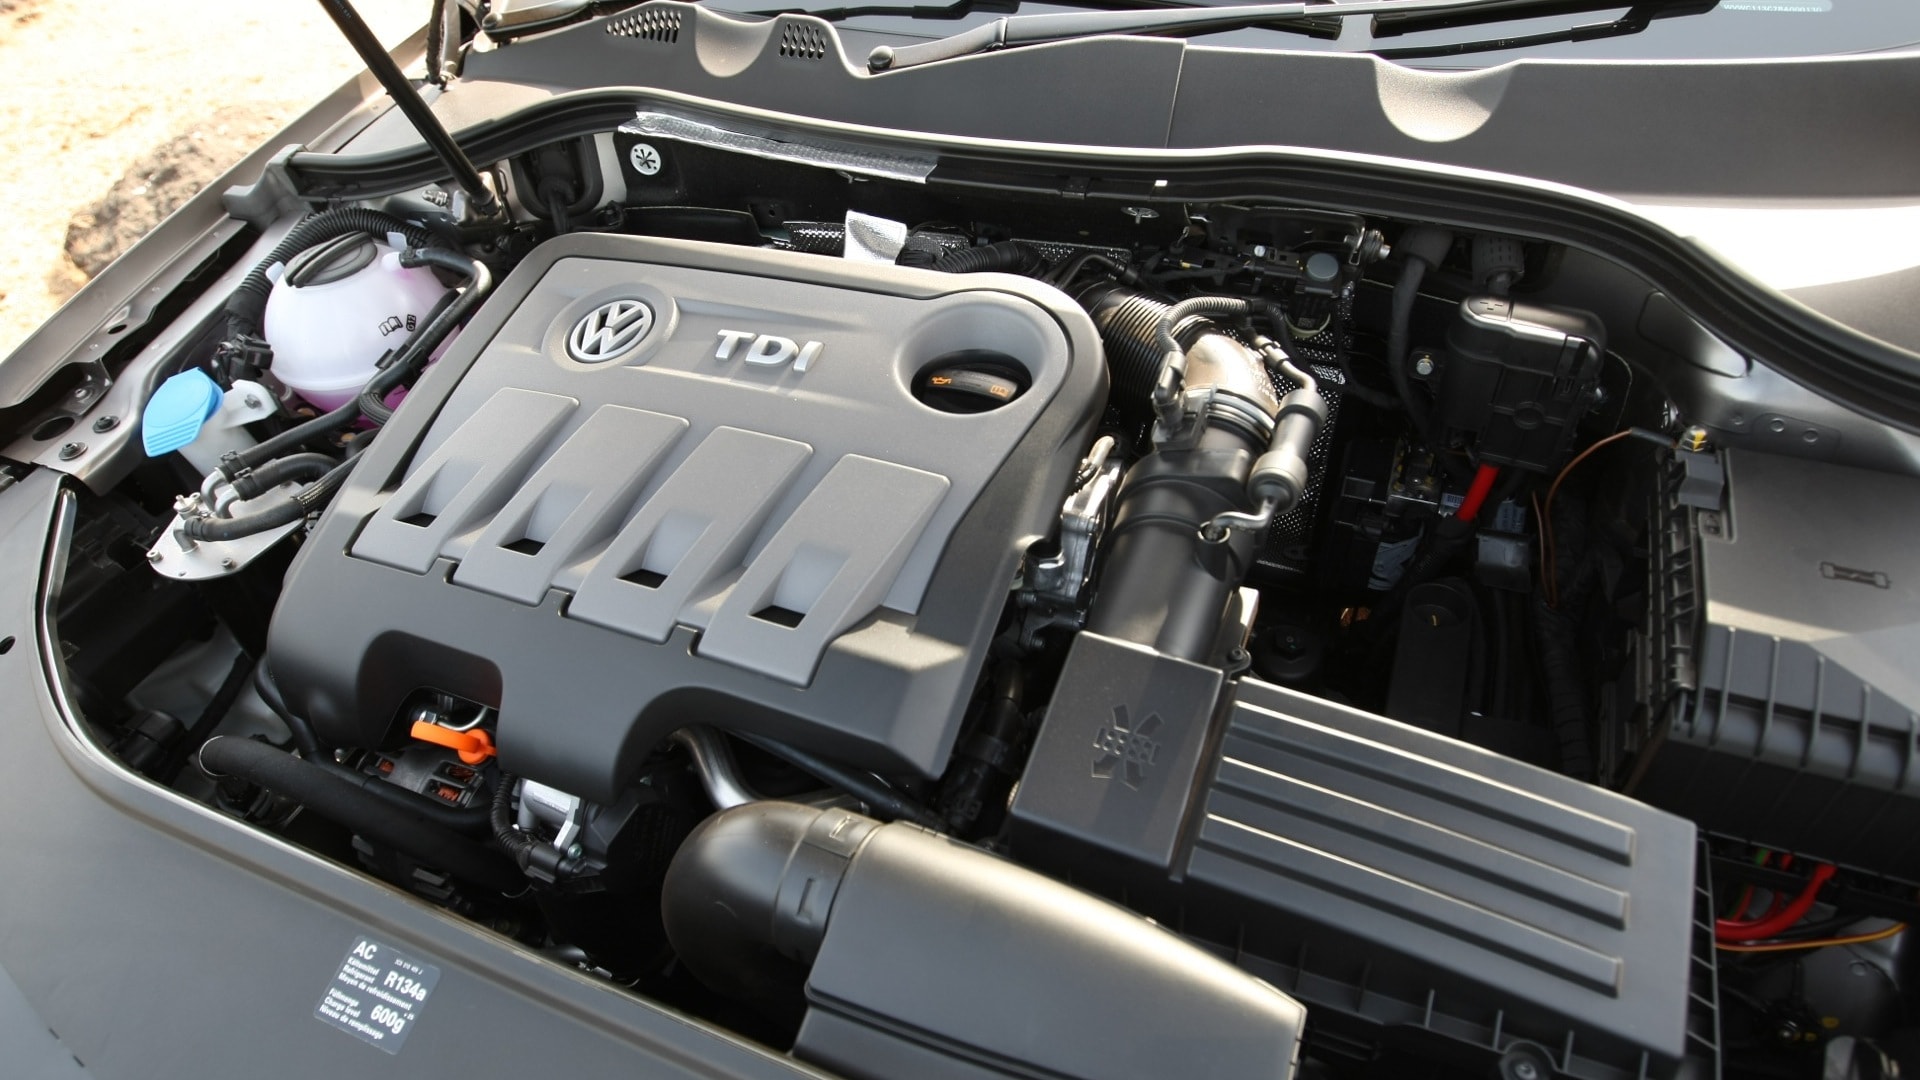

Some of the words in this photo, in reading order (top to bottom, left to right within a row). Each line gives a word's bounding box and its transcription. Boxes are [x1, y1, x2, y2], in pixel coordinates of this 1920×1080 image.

[406, 314, 416, 332] G12
[569, 300, 652, 362] VW
[715, 328, 825, 372] TDI
[353, 940, 377, 960] AC
[384, 970, 427, 1001] R134a
[319, 1004, 341, 1019] Niveau
[340, 1014, 349, 1024] de
[324, 996, 345, 1012] Charge
[344, 1003, 361, 1018] level
[370, 1004, 406, 1035] 600g
